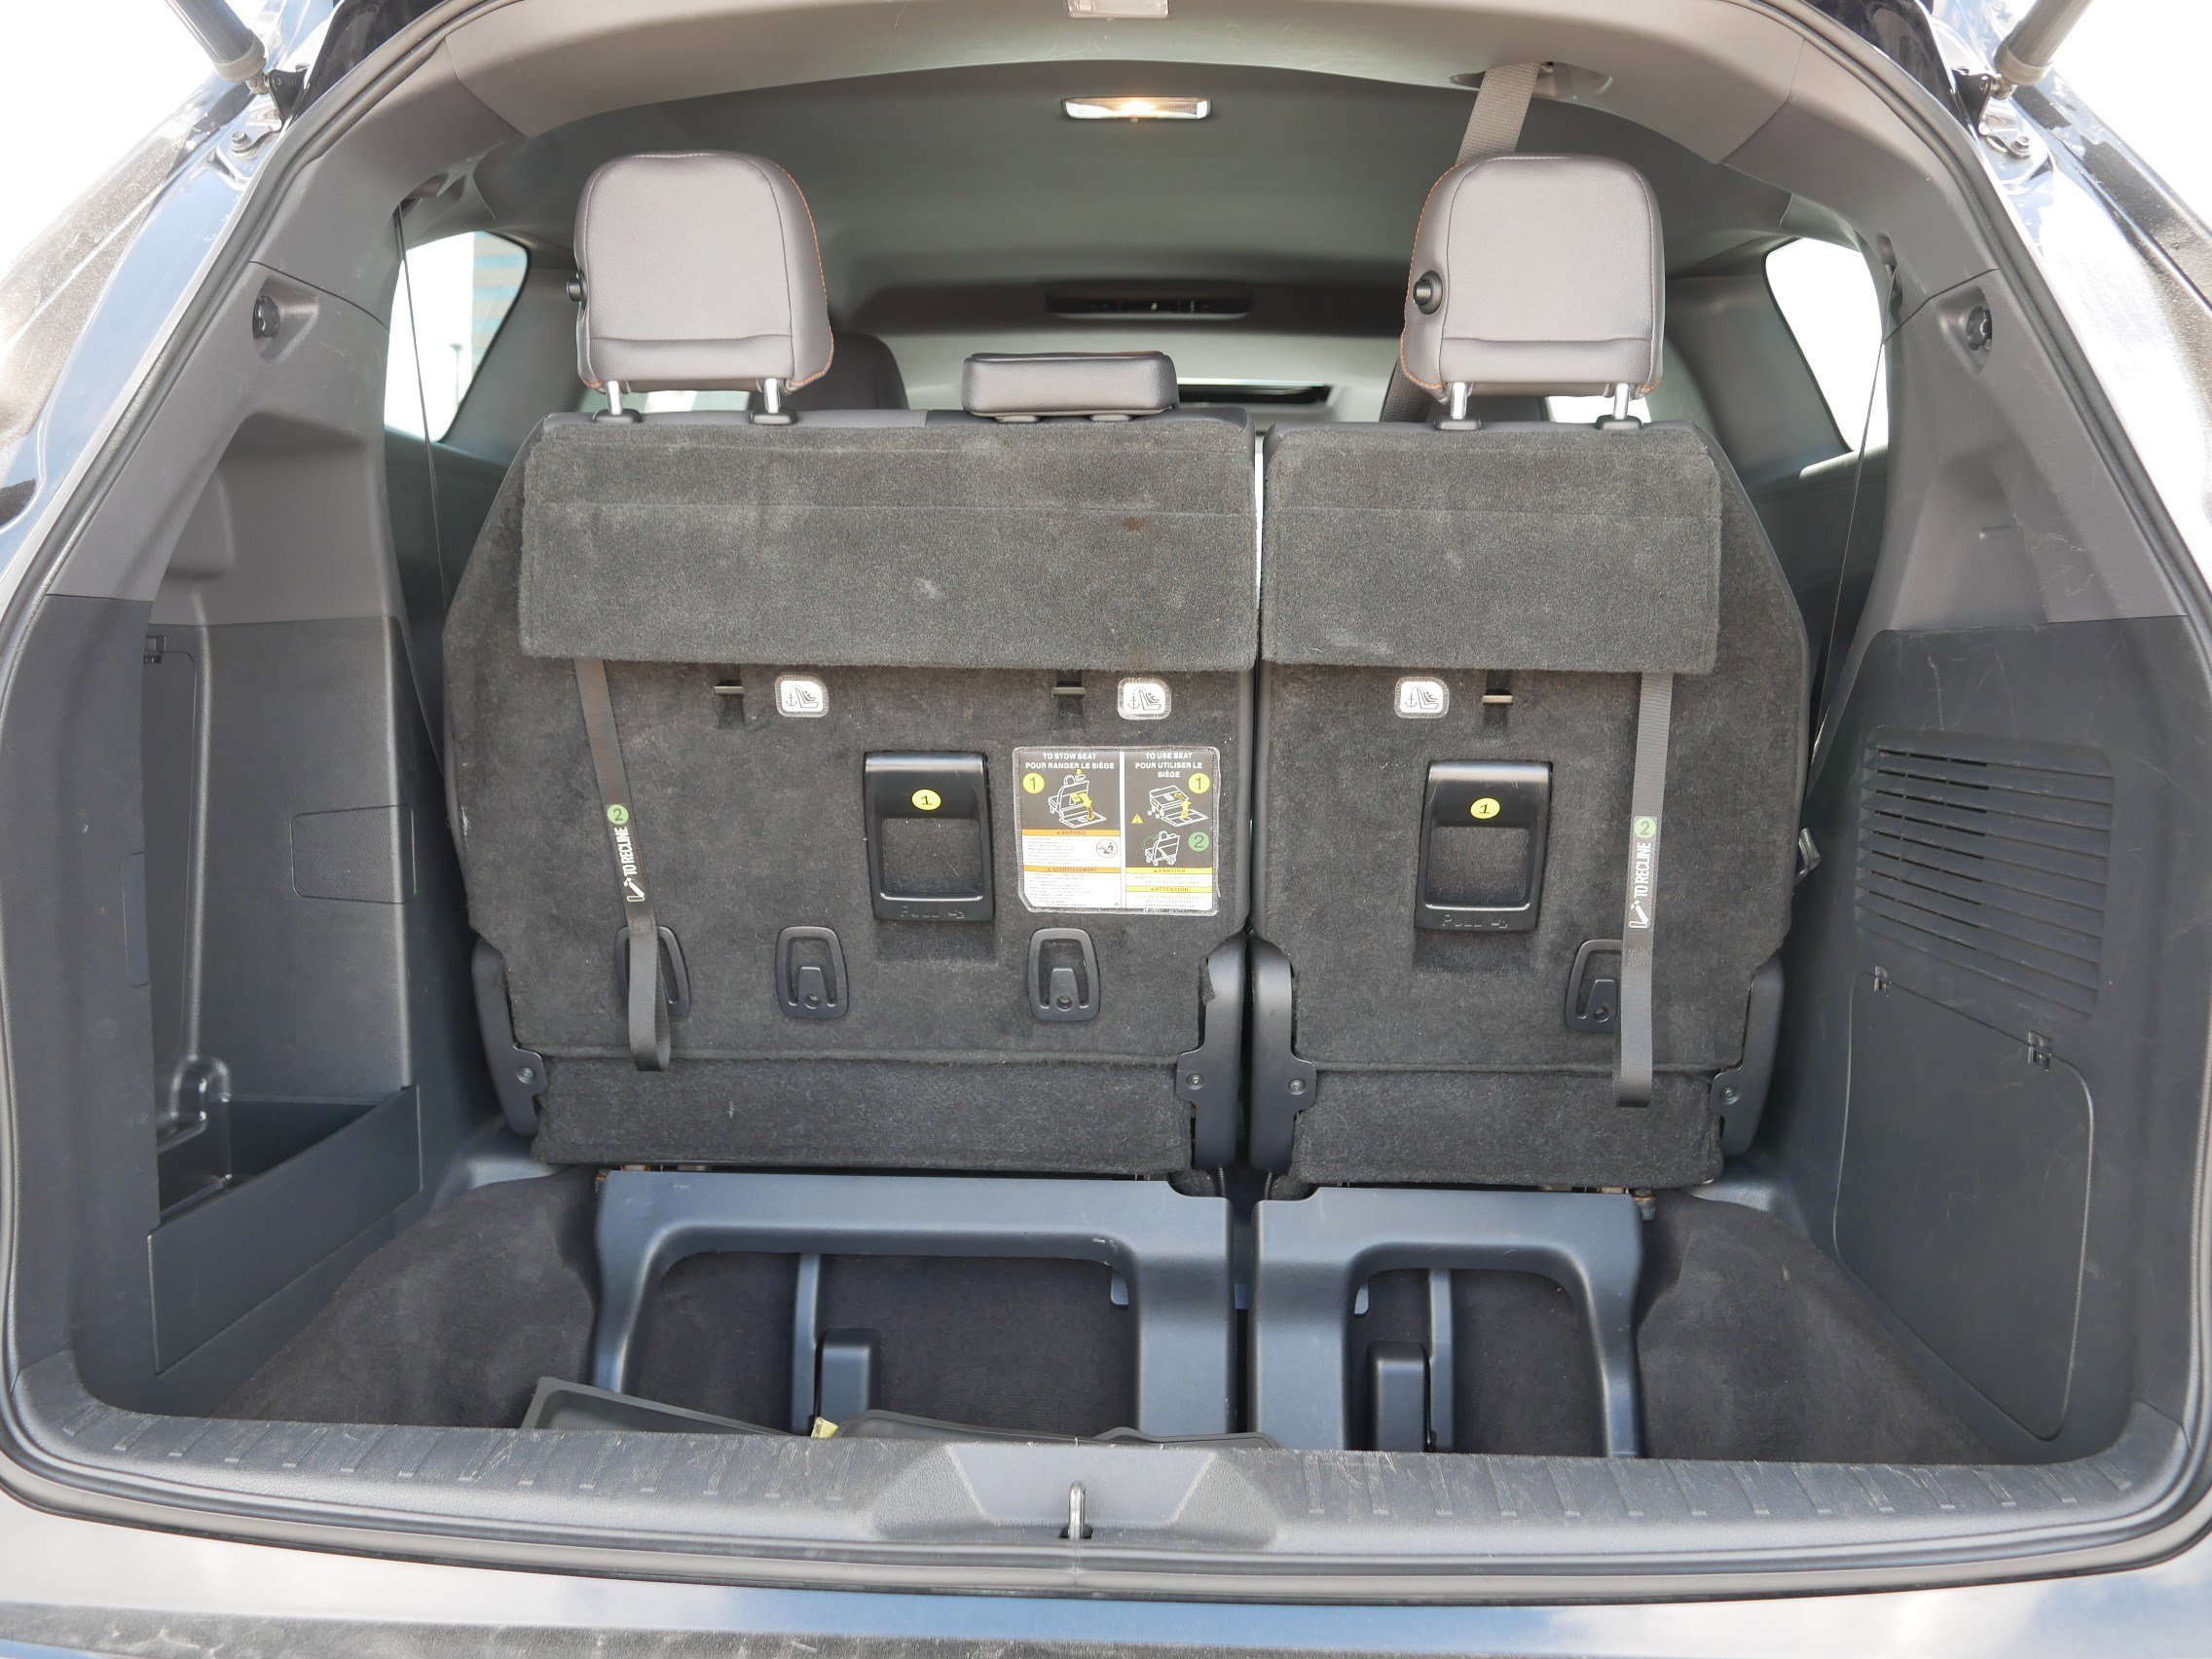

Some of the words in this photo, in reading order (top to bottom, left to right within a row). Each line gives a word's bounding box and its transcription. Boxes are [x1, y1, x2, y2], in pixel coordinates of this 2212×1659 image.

[1091, 760, 1115, 769] SIÈGE
[1030, 777, 1036, 791] 1
[1195, 776, 1201, 791] 1
[921, 794, 932, 806] 1
[612, 808, 623, 821] 2
[1479, 804, 1490, 814] 1
[1640, 821, 1650, 835] 2
[613, 826, 636, 865] RECLINE
[1194, 834, 1204, 848] 2
[1634, 841, 1651, 883] RECLINE
[622, 864, 638, 876] TO
[1633, 886, 1648, 898] TO
